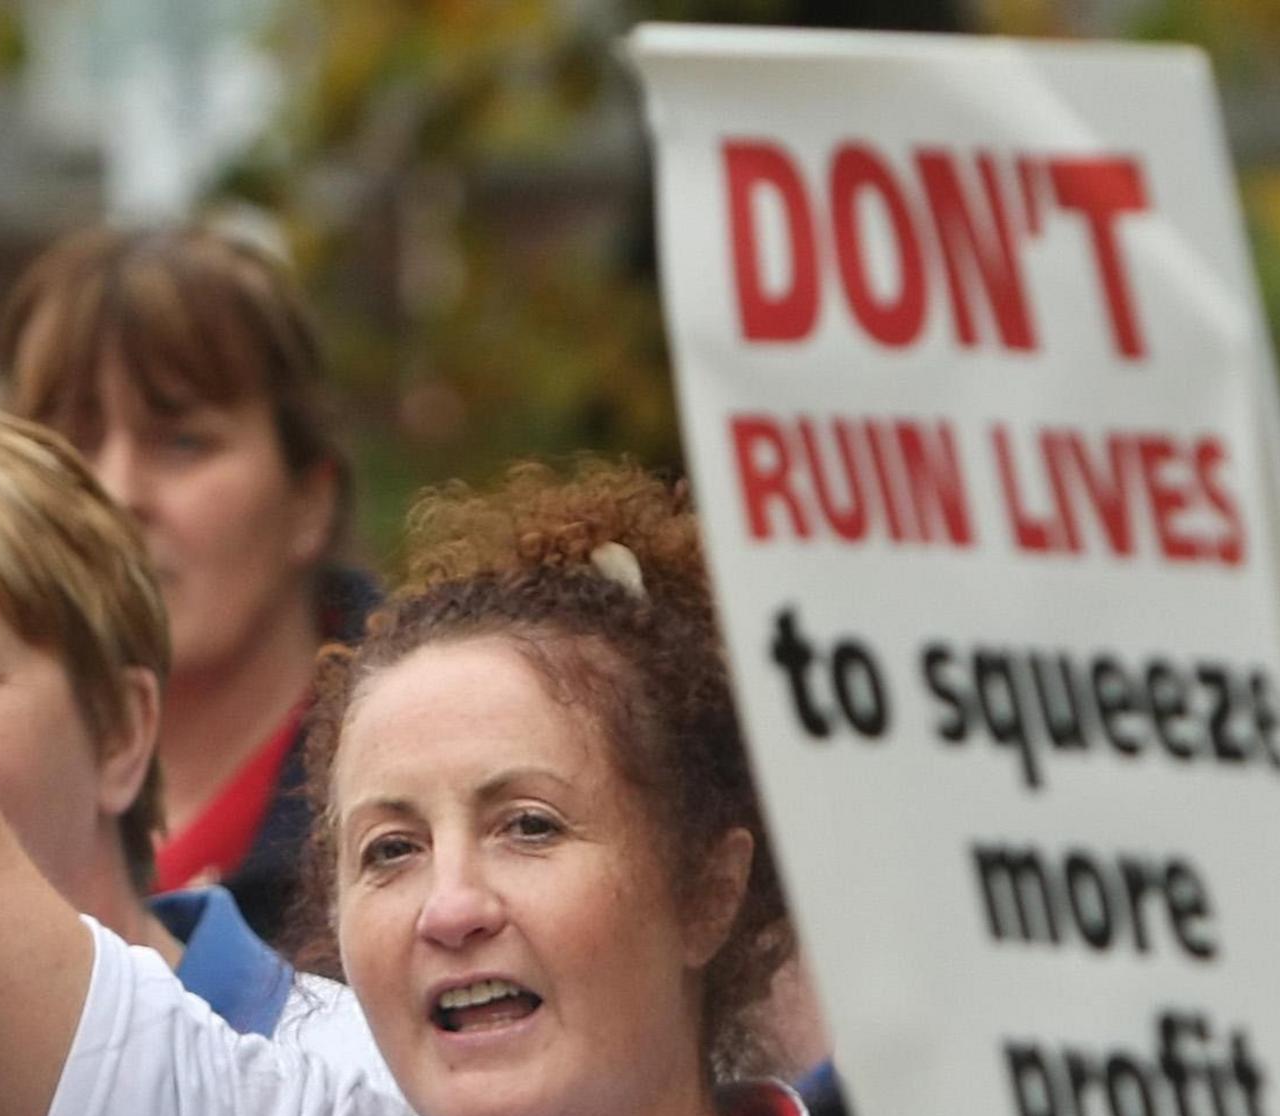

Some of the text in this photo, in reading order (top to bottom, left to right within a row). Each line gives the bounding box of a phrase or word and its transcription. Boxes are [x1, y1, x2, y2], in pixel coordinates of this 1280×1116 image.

[720, 137, 1151, 362] DON'T
[727, 414, 1245, 567] RUIN LIVES
[769, 609, 891, 741] to
[972, 846, 1216, 962] more
